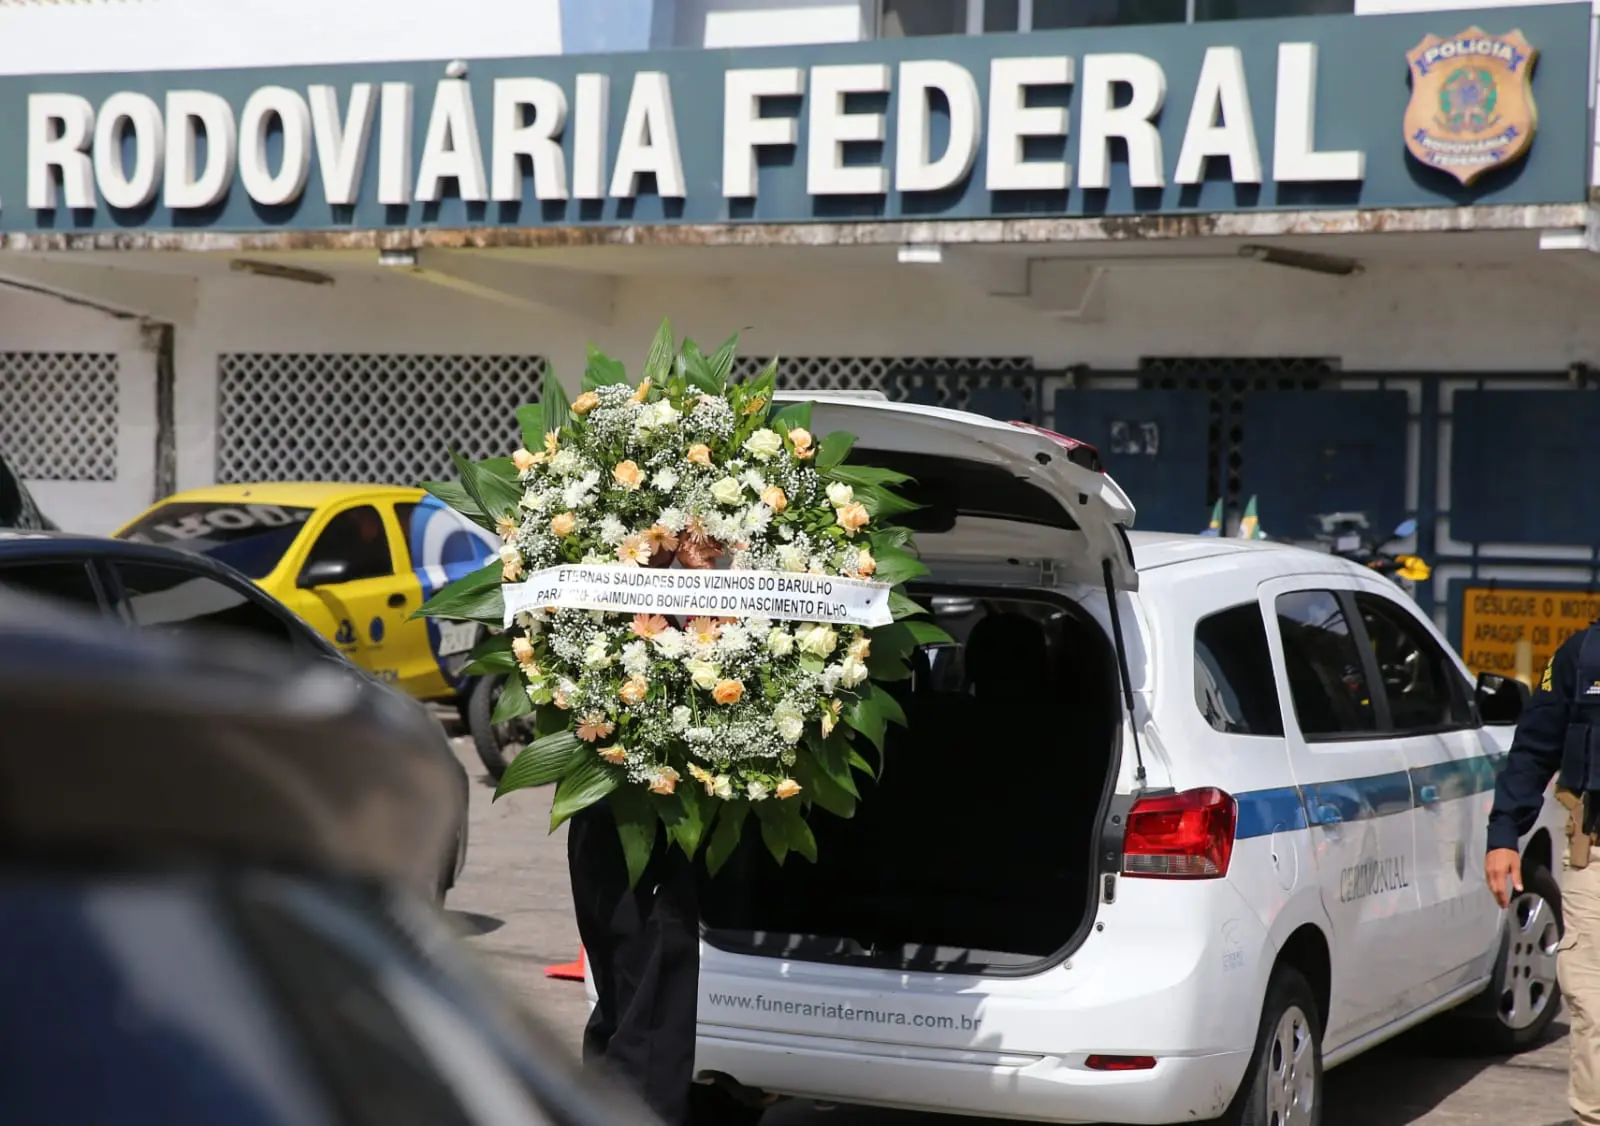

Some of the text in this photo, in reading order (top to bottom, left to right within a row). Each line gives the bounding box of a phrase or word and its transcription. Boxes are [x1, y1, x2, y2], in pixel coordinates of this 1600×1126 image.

[27, 42, 1365, 209] RODOVIÁRIA FEDERAL
[558, 569, 833, 596] ETERNAS SAUDADES DOS VIZINHOS DO BARULHO
[656, 592, 718, 609] BONIFÁCIO
[721, 596, 737, 610] DO
[740, 597, 814, 615] NASCIMENTO
[817, 601, 847, 617] FILHO
[1474, 595, 1600, 620] DESLIGUE O MOTO
[1474, 623, 1525, 644] APAGUE
[1532, 625, 1550, 646] OS
[1340, 855, 1409, 903] CERIMONIAL
[708, 992, 983, 1031] www.funerariaternura.com.br
